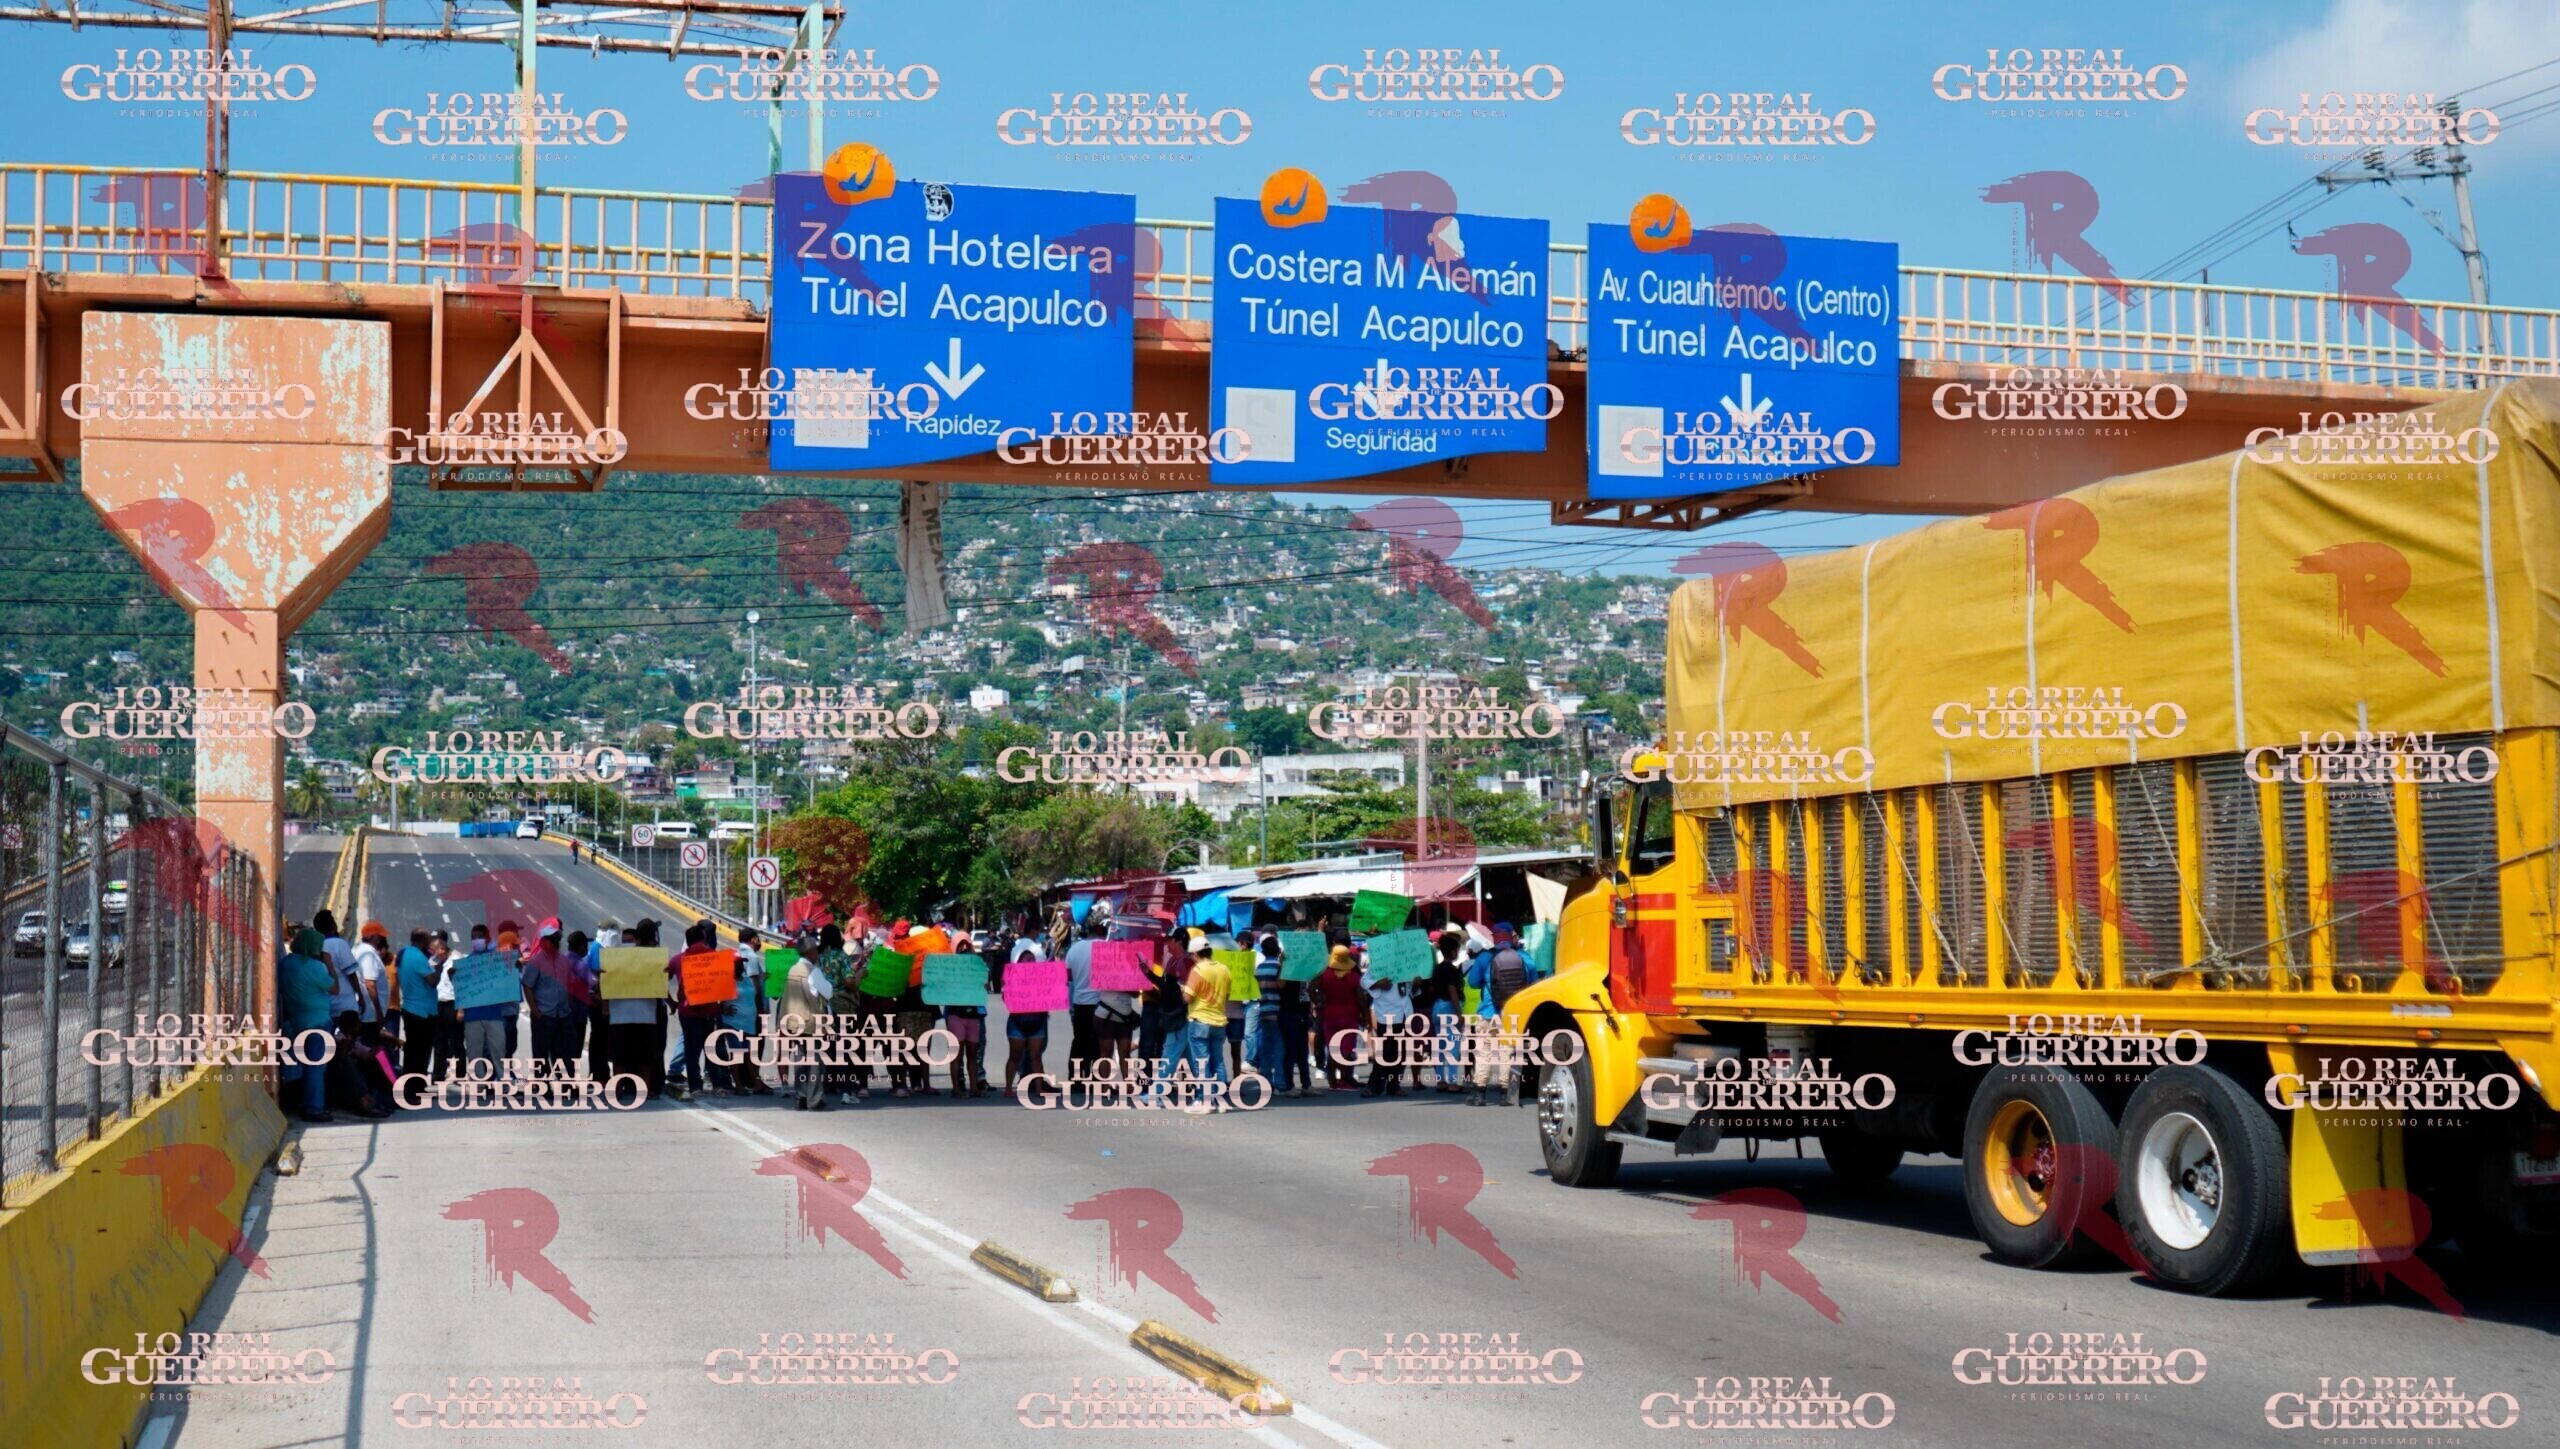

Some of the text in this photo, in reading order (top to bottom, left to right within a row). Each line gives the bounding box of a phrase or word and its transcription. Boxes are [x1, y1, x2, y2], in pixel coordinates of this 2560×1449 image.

[799, 222, 1112, 274] Zona Hotelera
[1229, 244, 1536, 297] Costera M Alemán
[802, 277, 1108, 332] Túnel Acapulco
[1599, 268, 1890, 326] Av. Cuauhtémoc (Centro)
[1242, 298, 1523, 351] Túnel Acapulco
[1614, 319, 1877, 370] Túnel Acapulco
[906, 413, 1001, 439] Rapidez
[1326, 427, 1437, 455] Seguridad
[638, 829, 649, 839] 60
